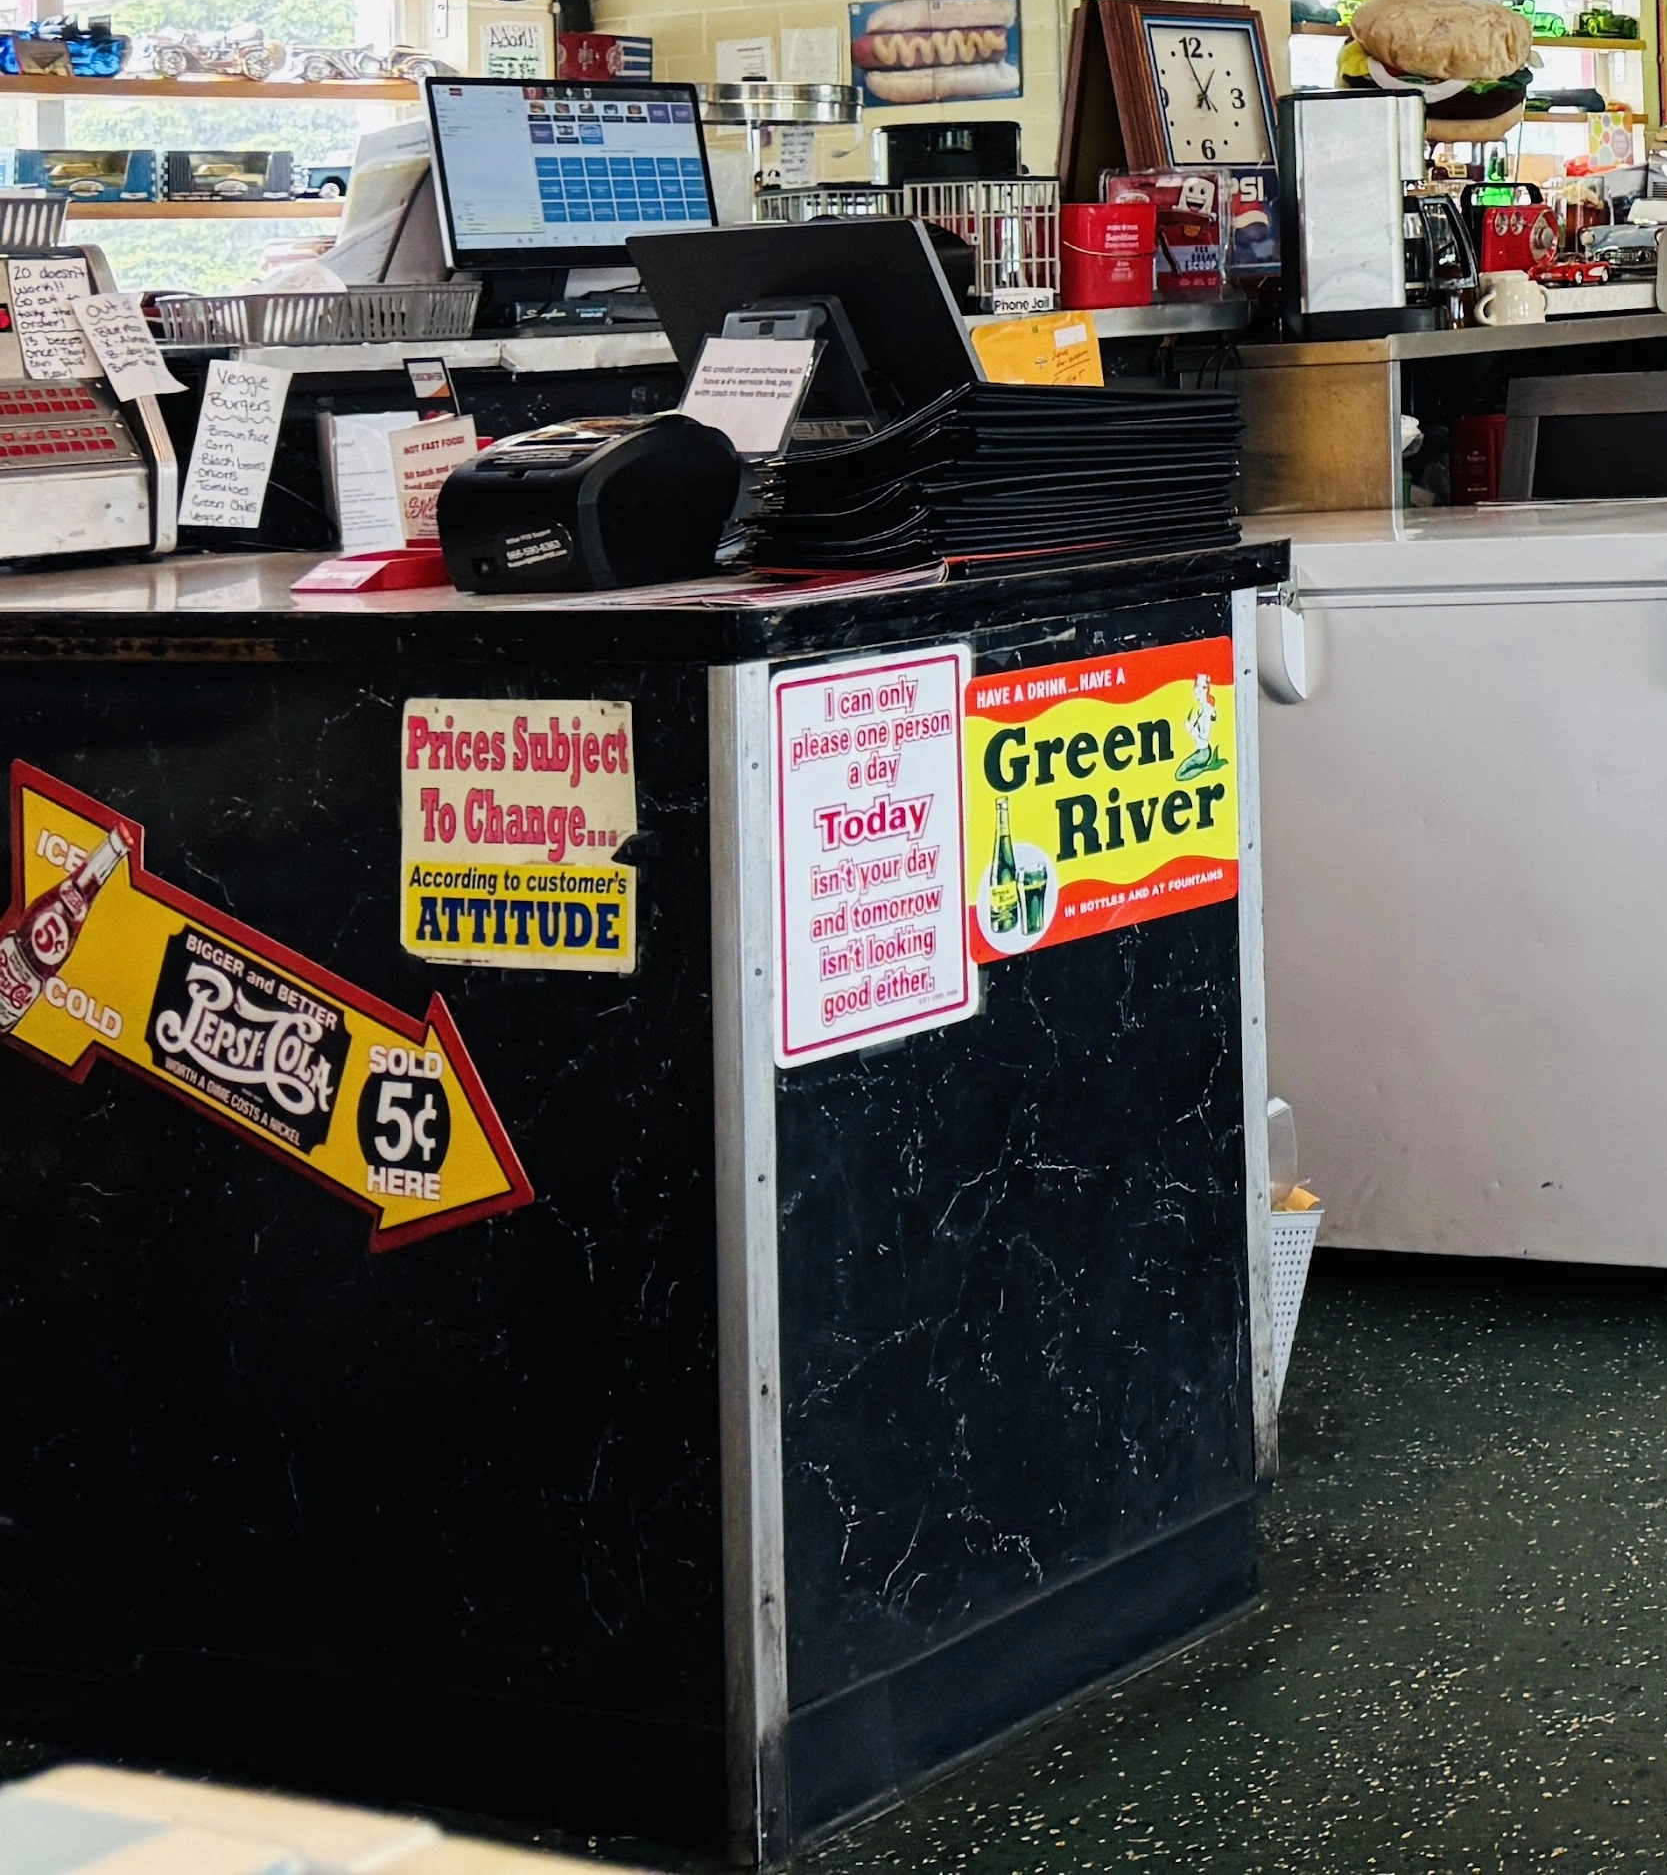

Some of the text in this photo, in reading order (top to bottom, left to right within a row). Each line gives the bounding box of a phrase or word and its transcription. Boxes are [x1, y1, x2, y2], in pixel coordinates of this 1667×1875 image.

[1178, 36, 1204, 59] 12
[1230, 87, 1246, 109] 3
[1201, 138, 1217, 161] 6
[13, 266, 31, 281] 20
[14, 296, 33, 308] Go
[826, 676, 917, 720] I can only
[976, 686, 1011, 710] HAVE
[1013, 685, 1025, 703] A
[1115, 666, 1126, 685] A
[405, 714, 629, 788] Prices Subject
[792, 710, 951, 769] please one person
[983, 718, 1175, 794] Green
[848, 754, 899, 788] a day
[419, 787, 457, 844] To
[817, 796, 931, 850] Today
[1055, 782, 1226, 863] River
[35, 828, 89, 874] ICE
[811, 845, 939, 899] isn't your day
[408, 864, 627, 896] According to customer's
[1064, 868, 1224, 918] IN BOTTLES AND AT FOUNTAINS
[415, 896, 620, 950] ATTITUDE
[811, 886, 942, 940] and tomorrow
[821, 926, 934, 981] isn't looking
[44, 976, 123, 1039] COLD
[185, 933, 338, 1031] BIGGER and BETTER
[823, 984, 871, 1024] good
[875, 968, 934, 1003] either.
[367, 1043, 443, 1080] SOLD
[164, 1056, 301, 1147] WORTH A DIME COSTS A NICKEL
[373, 1080, 438, 1163] 5¢
[366, 1164, 442, 1201] HERE
